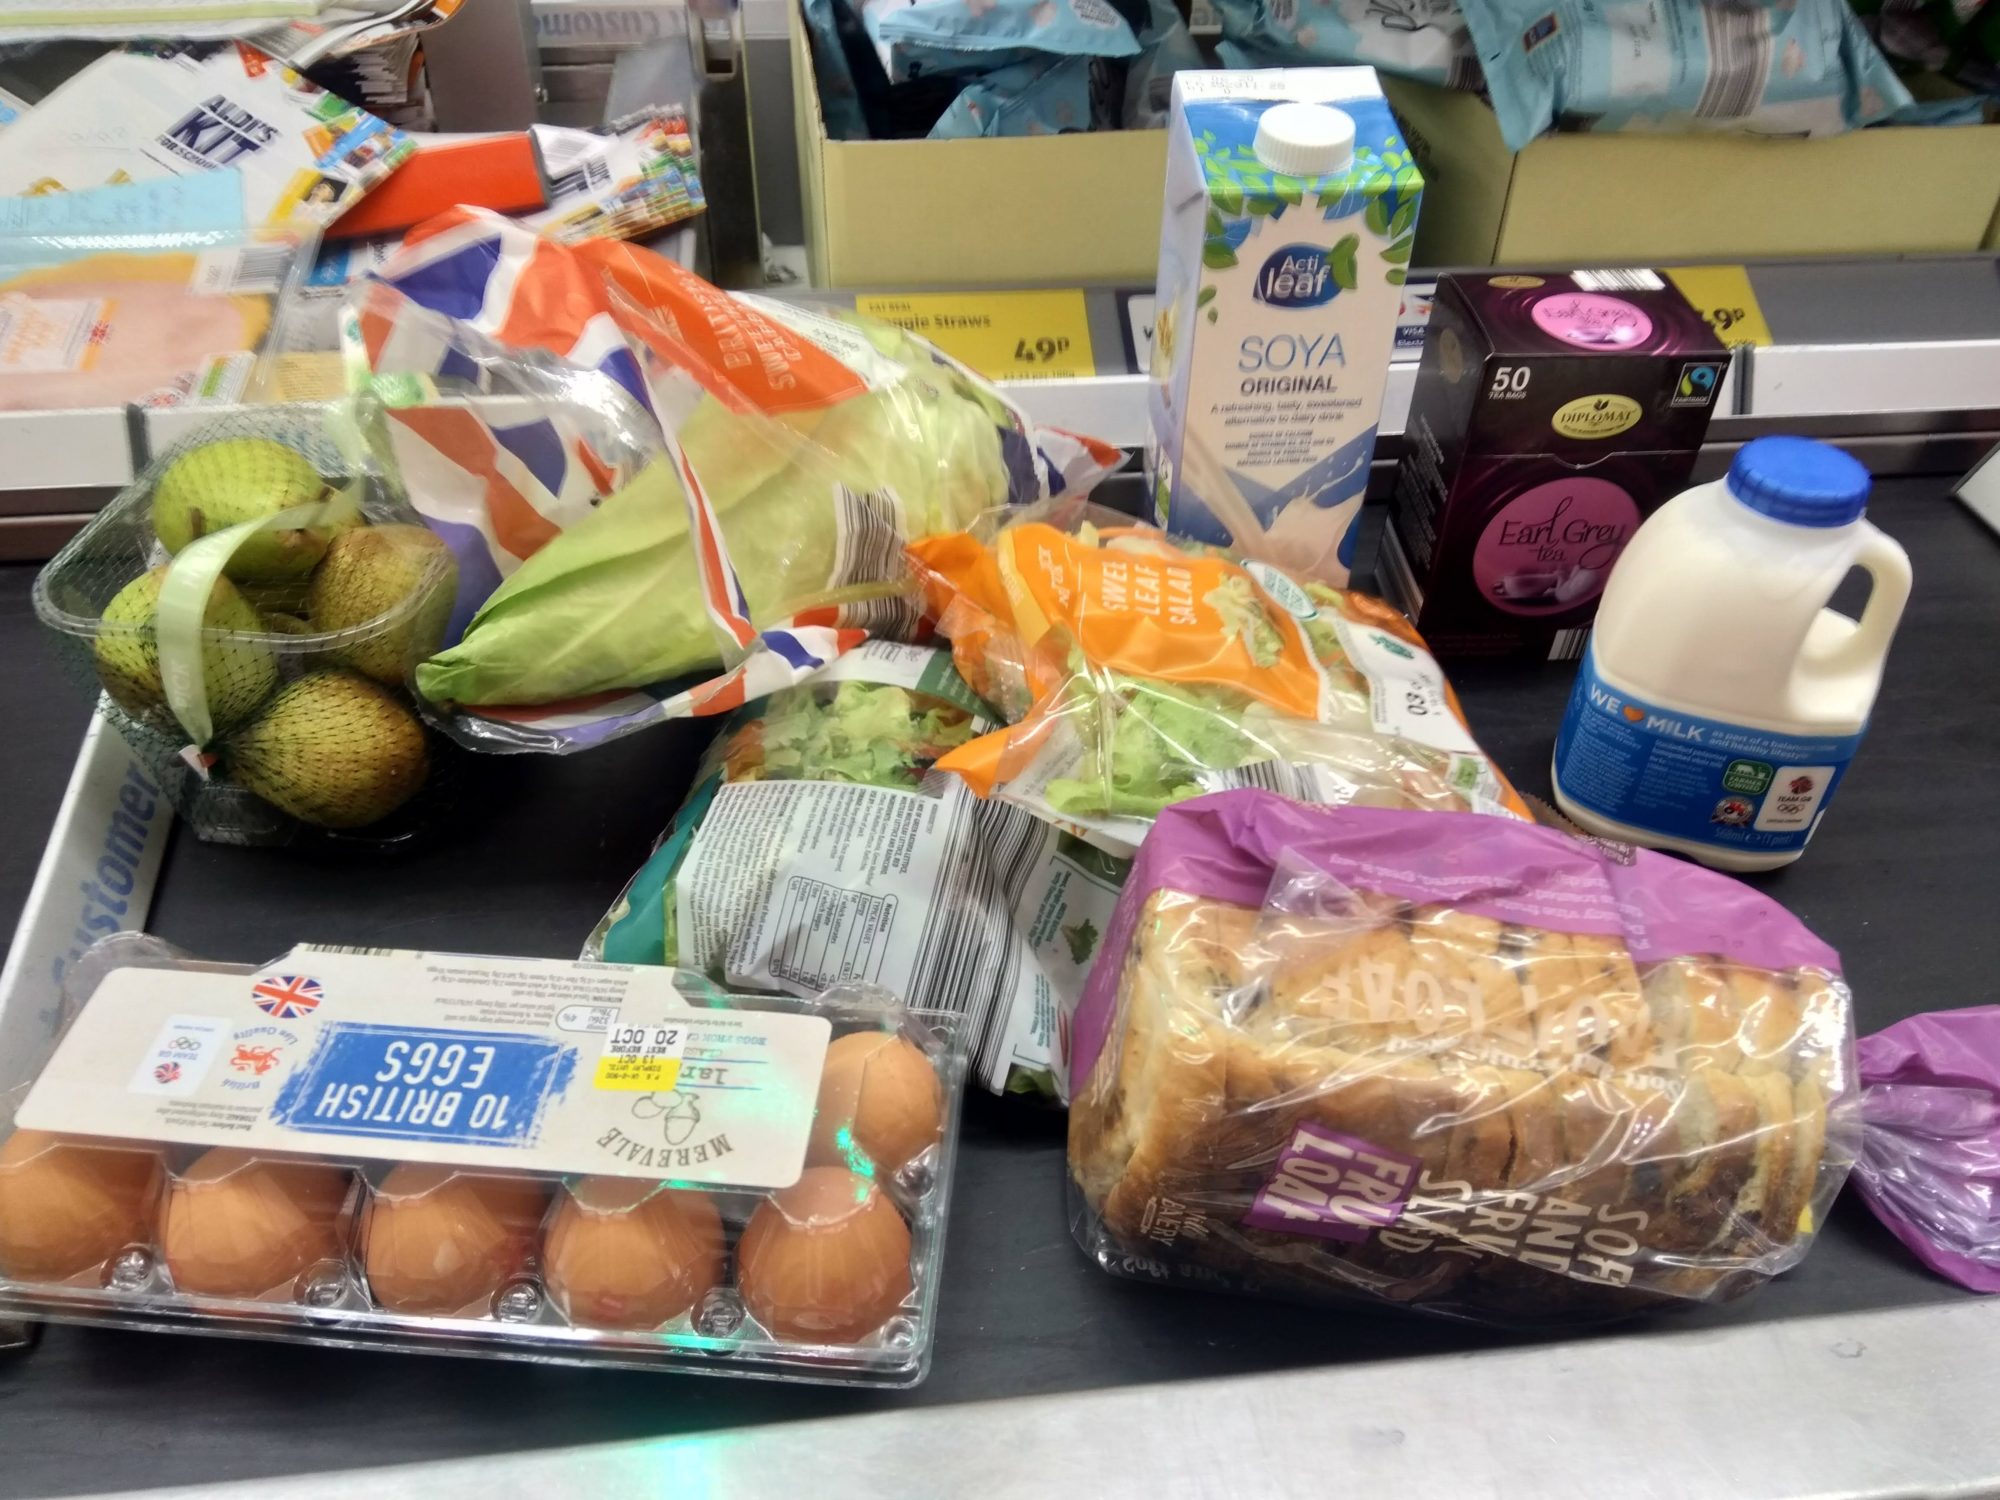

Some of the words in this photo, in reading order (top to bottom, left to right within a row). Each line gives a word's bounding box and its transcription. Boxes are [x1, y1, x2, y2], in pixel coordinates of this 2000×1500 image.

[165, 105, 261, 166] KIT
[1280, 254, 1320, 273] Acti
[1266, 264, 1332, 299] leaf
[935, 315, 991, 327] Straws
[1706, 307, 1745, 331] 9p
[1238, 333, 1346, 373] SOYA
[1240, 375, 1338, 396] ORIGINAL
[1491, 367, 1530, 392] 50
[1488, 391, 1505, 400] TEA
[1507, 390, 1527, 399] BAGS
[1561, 408, 1633, 424] DIPLOMAT
[1499, 497, 1573, 546] Earl
[1564, 520, 1627, 569] Grey
[1535, 548, 1564, 561] tea
[1134, 564, 1160, 619] LEAF
[1168, 567, 1197, 625] SALAD
[1590, 683, 1622, 712] WE
[1646, 715, 1705, 743] MILK
[1709, 739, 1728, 747] and
[1730, 741, 1768, 754] healthy
[1725, 733, 1748, 743] part
[798, 880, 809, 902] Protein
[810, 883, 819, 898] Fibre
[850, 894, 858, 903] Fat
[817, 895, 827, 913] which
[837, 900, 846, 917] which
[856, 896, 867, 916] Energy
[867, 899, 879, 923] TYPICAL
[878, 902, 891, 932] Nutrition
[830, 917, 841, 944] saturates
[862, 923, 873, 944] VALUES
[610, 1027, 646, 1045] OCT
[653, 1029, 679, 1045] 20
[610, 1044, 642, 1054] BEFORE
[617, 1053, 638, 1063] OCT
[648, 1045, 667, 1054] BEST
[373, 1037, 496, 1090] EGGS
[219, 1078, 261, 1091] British
[678, 1064, 730, 1085] lar
[313, 1080, 463, 1129] BRITISH
[467, 1091, 510, 1131] 10
[597, 1127, 734, 1168] MEREVALE
